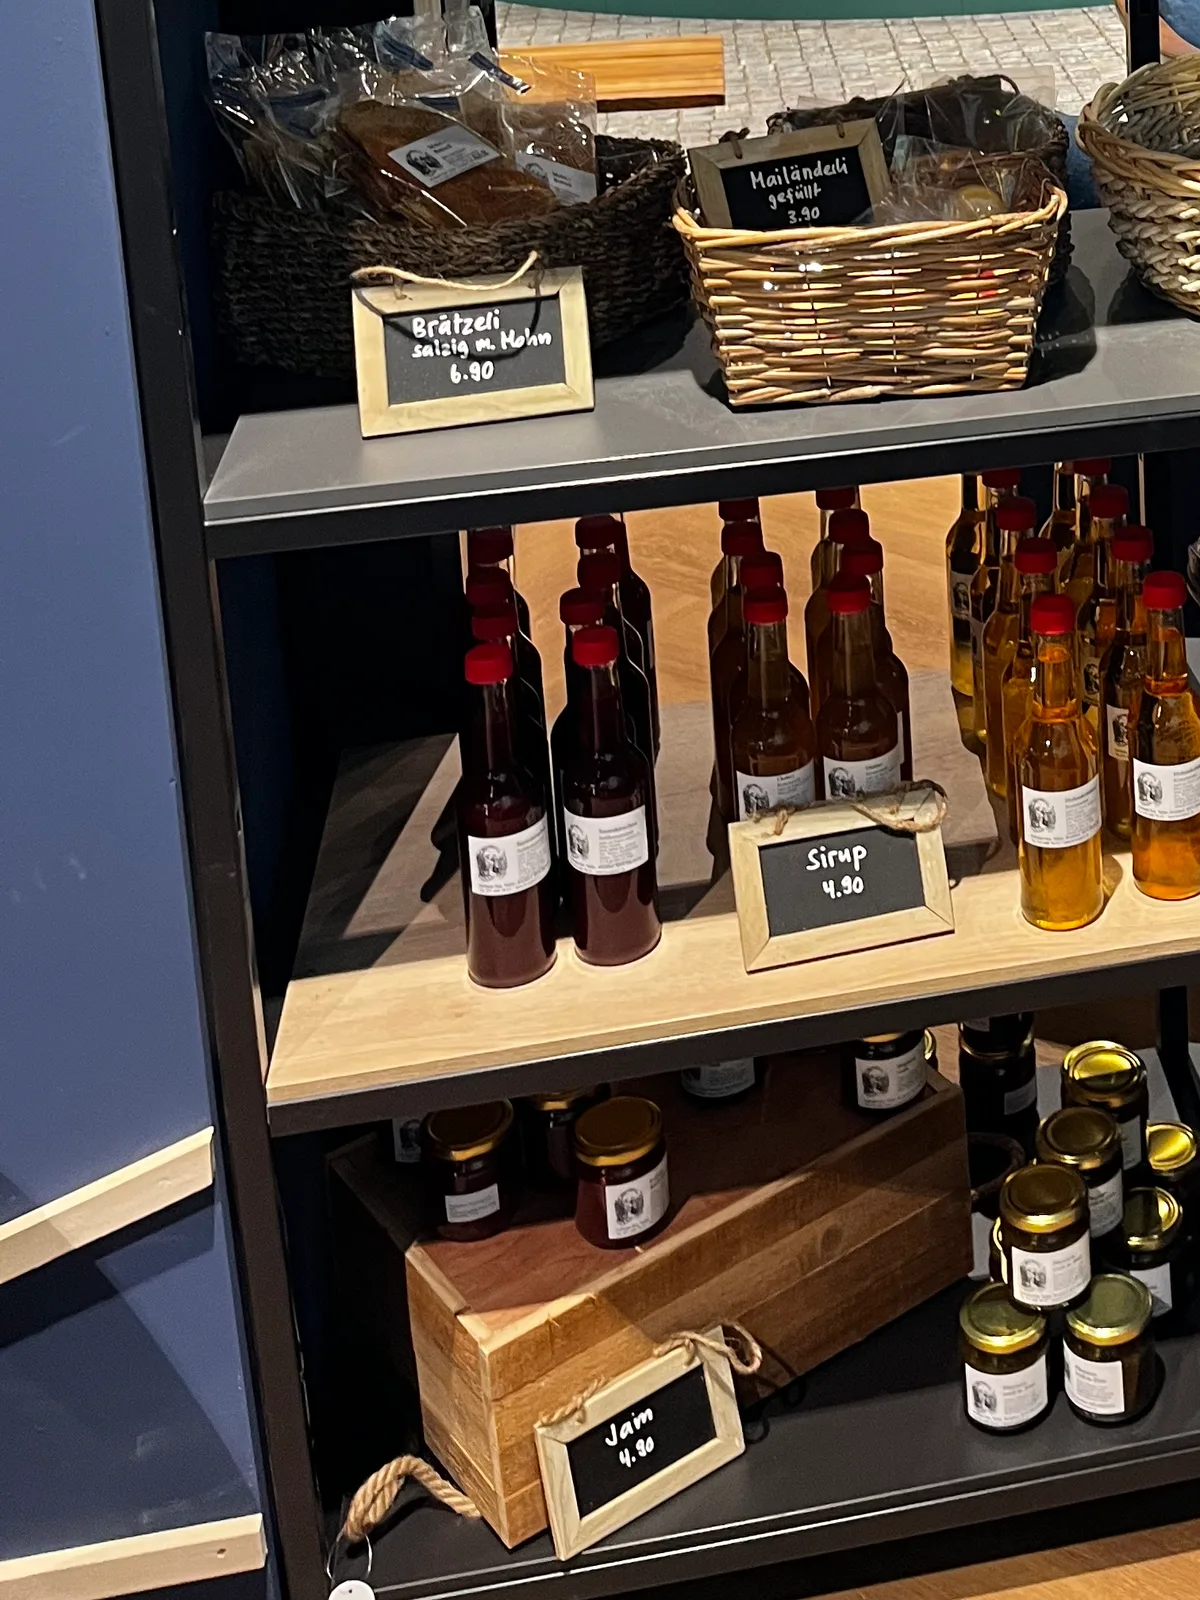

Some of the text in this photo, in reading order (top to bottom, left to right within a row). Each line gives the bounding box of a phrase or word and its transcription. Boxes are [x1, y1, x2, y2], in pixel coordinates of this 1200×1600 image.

[750, 156, 849, 190] Mailänderli
[768, 182, 822, 211] gefüllt
[787, 206, 820, 225] 3.90
[411, 308, 500, 339] Brätzeli
[411, 327, 552, 360] salzig m. Mohn
[450, 360, 495, 385] 6.90
[805, 845, 868, 872] Sirup
[822, 875, 865, 899] 4.90
[619, 1435, 655, 1468] 4.90
